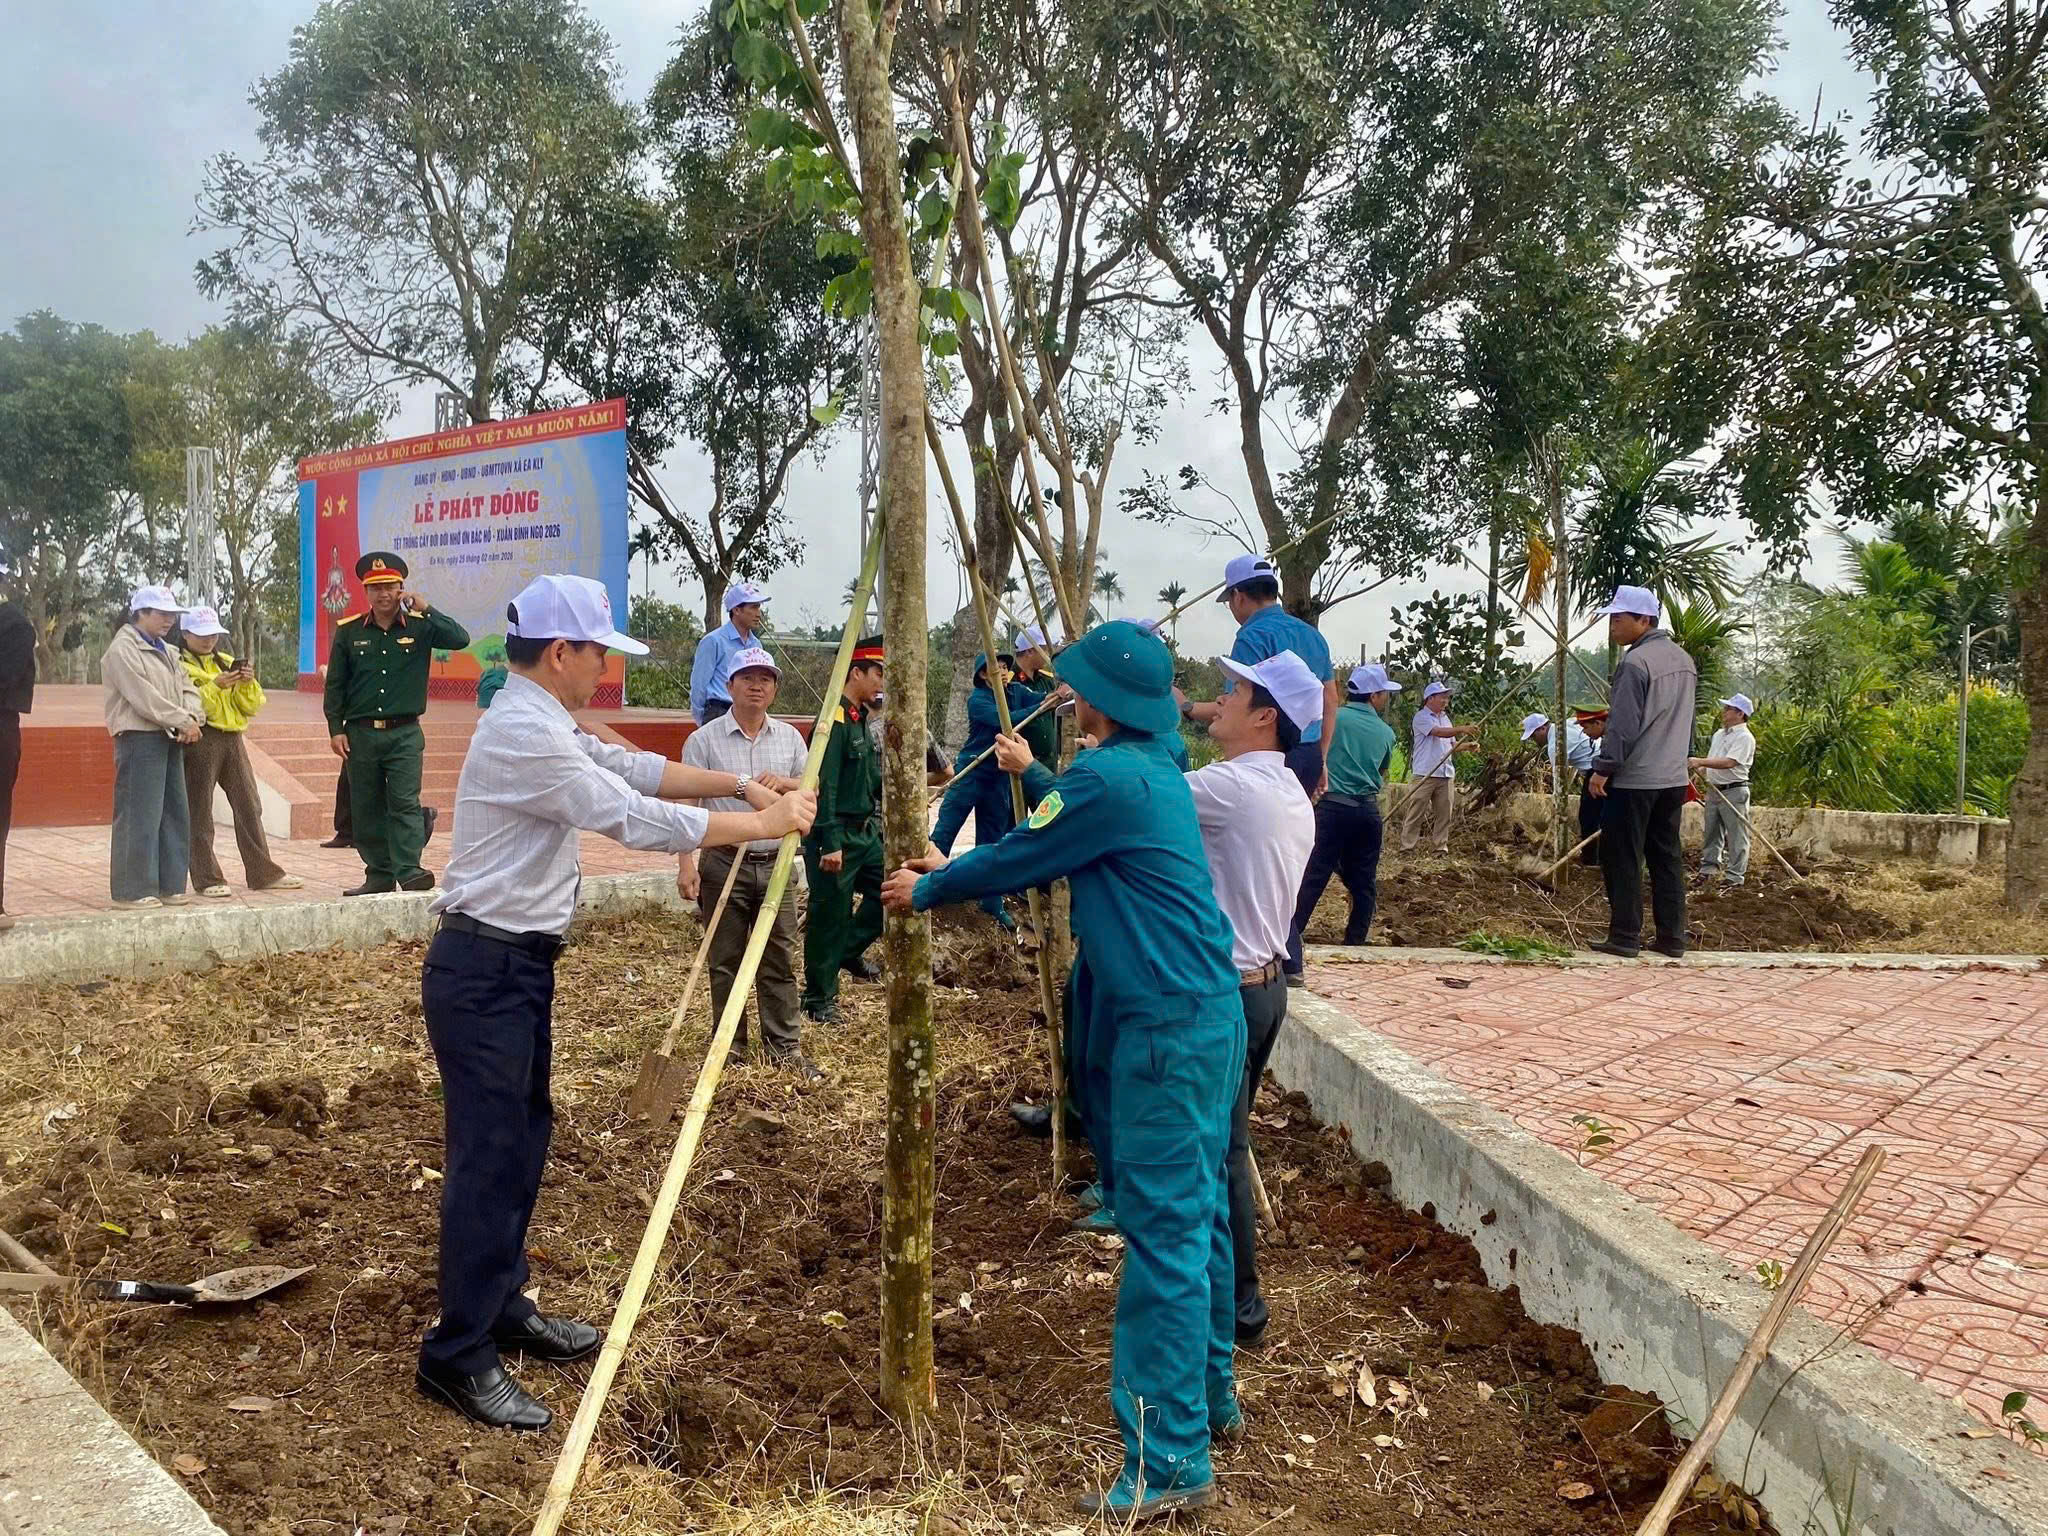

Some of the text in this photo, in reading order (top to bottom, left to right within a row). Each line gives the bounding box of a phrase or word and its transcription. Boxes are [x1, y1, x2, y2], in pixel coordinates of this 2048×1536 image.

[437, 433, 472, 452] NGHĨA
[475, 428, 502, 446] VIỆT
[506, 425, 533, 441] NAM
[537, 415, 574, 435] MUÔN
[414, 487, 540, 524] LỄ PHÁT ĐỘNG
[545, 524, 561, 538] 2026
